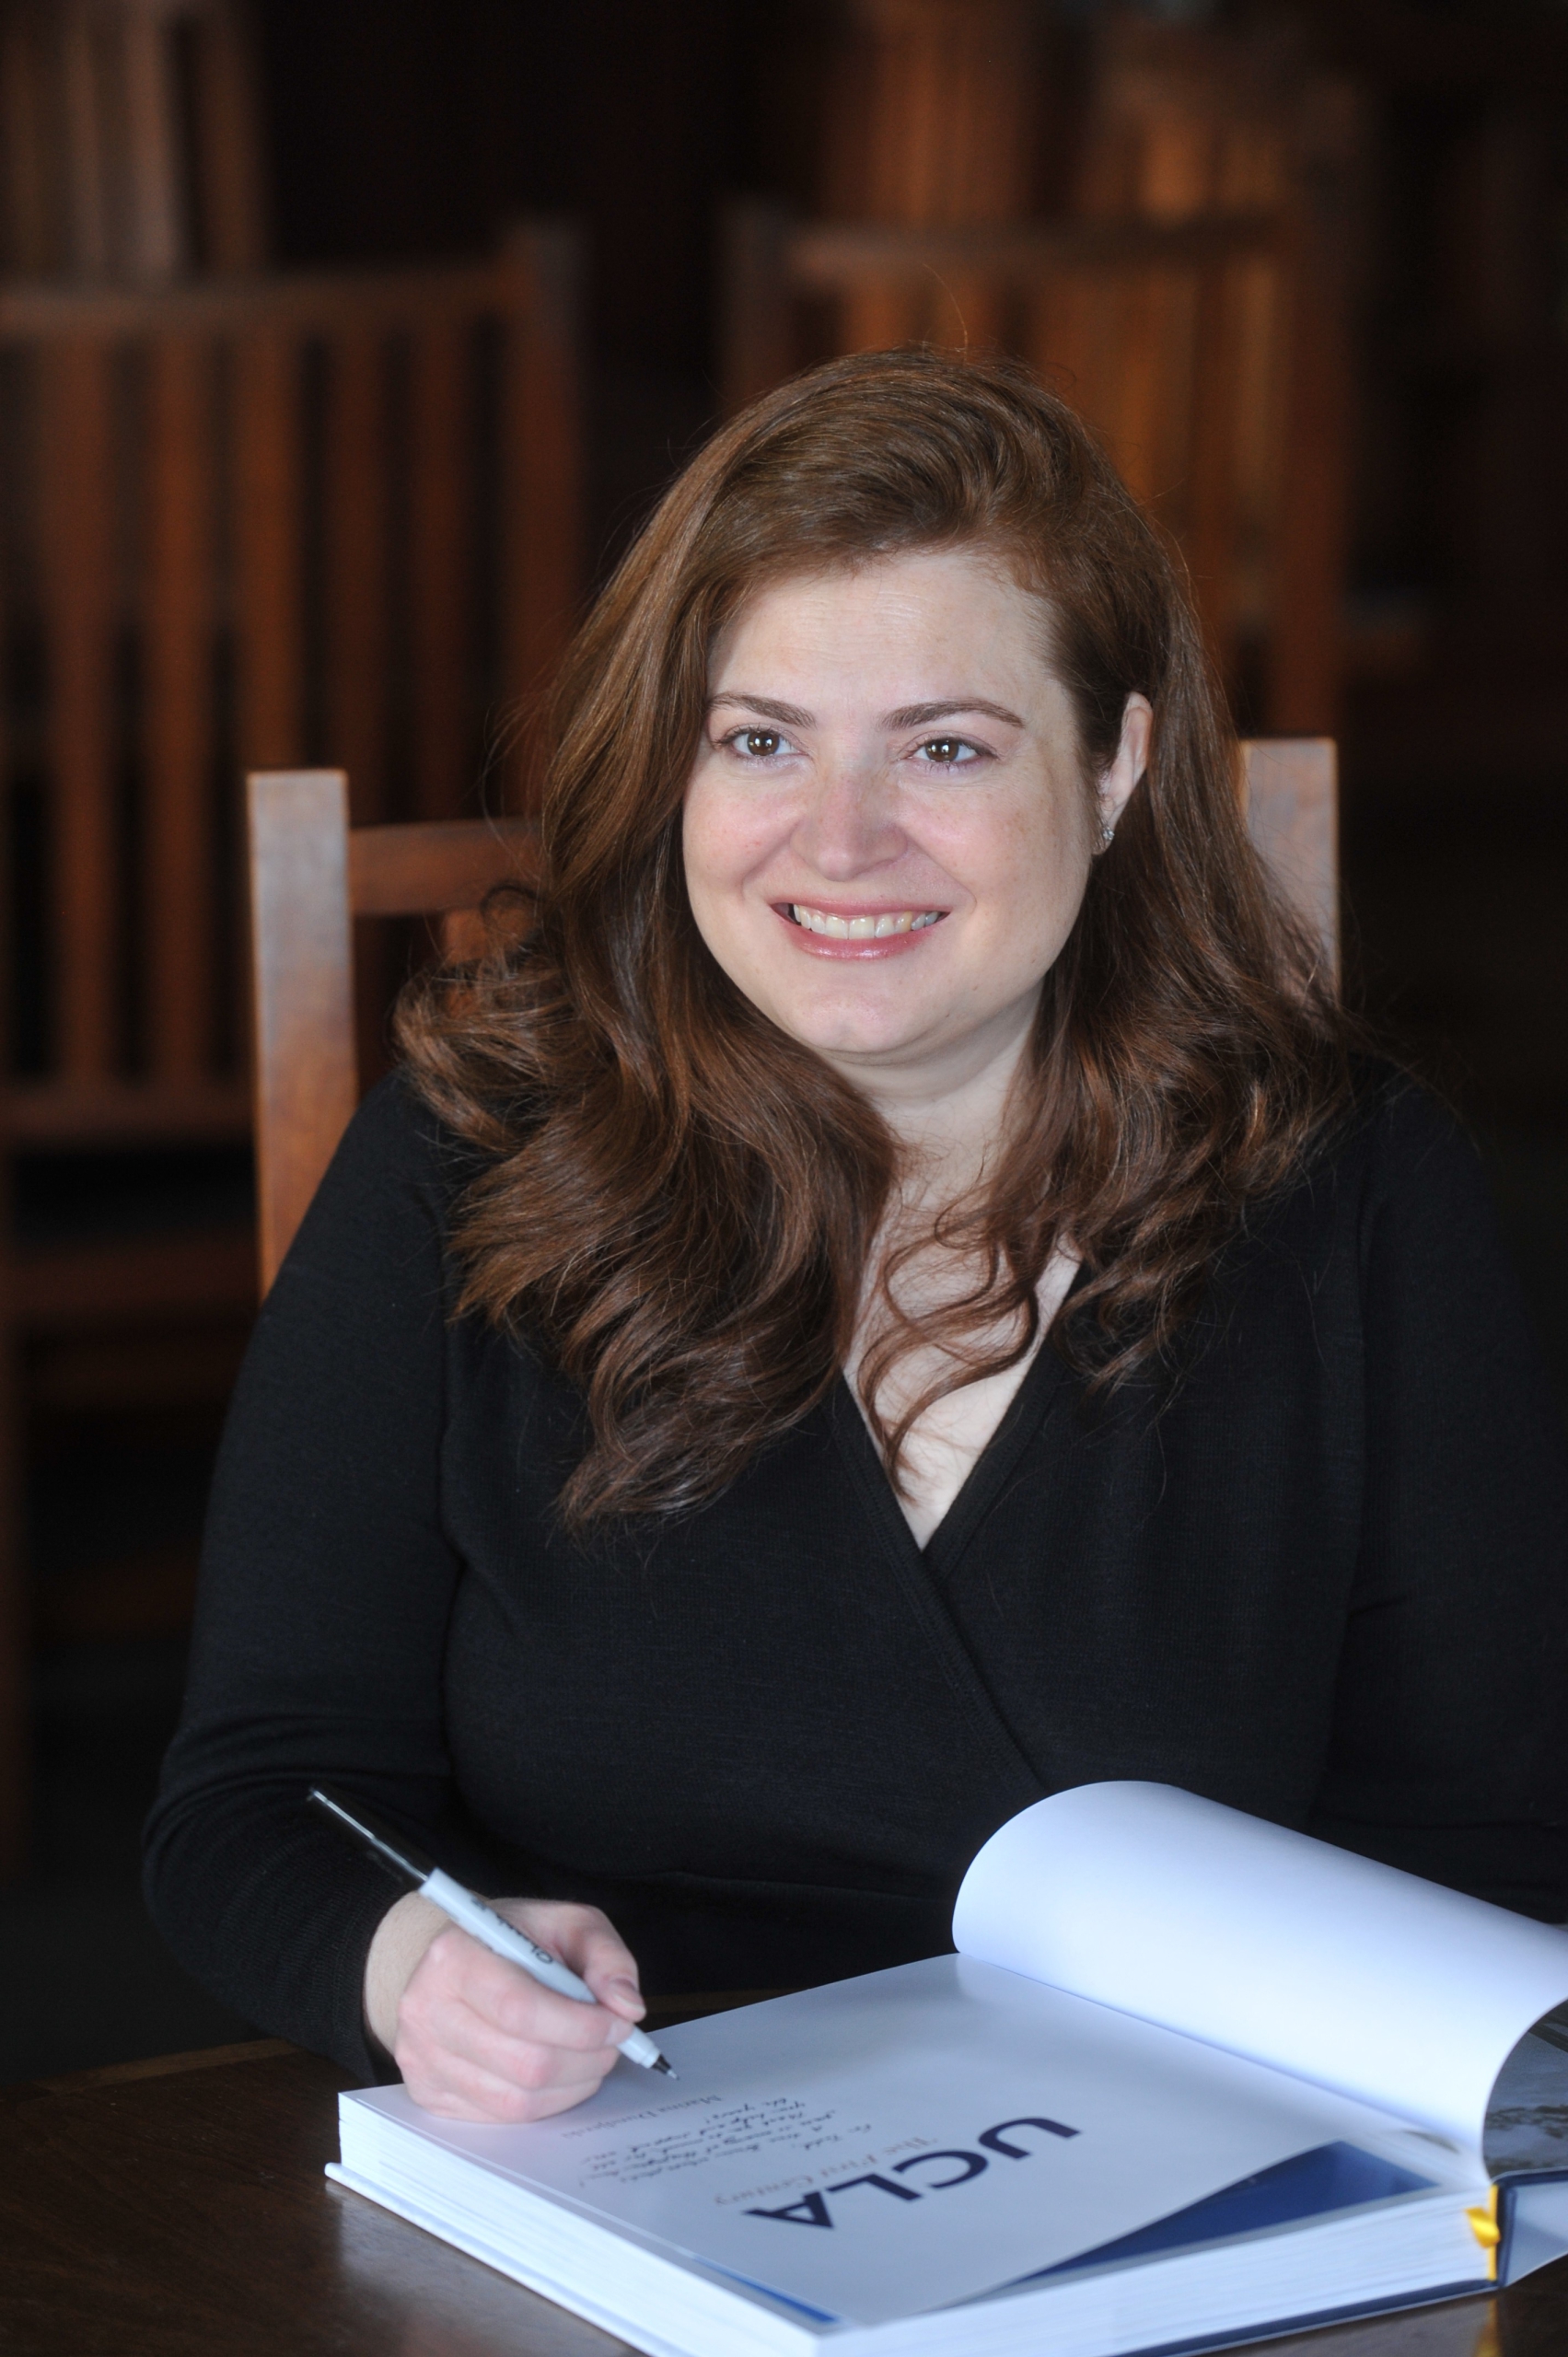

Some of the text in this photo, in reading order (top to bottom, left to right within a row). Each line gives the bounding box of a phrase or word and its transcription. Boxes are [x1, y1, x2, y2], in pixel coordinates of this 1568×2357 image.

[658, 2095, 723, 2113] Marina
[714, 2137, 937, 2207] The First Century
[740, 2116, 1082, 2229] UCLA
